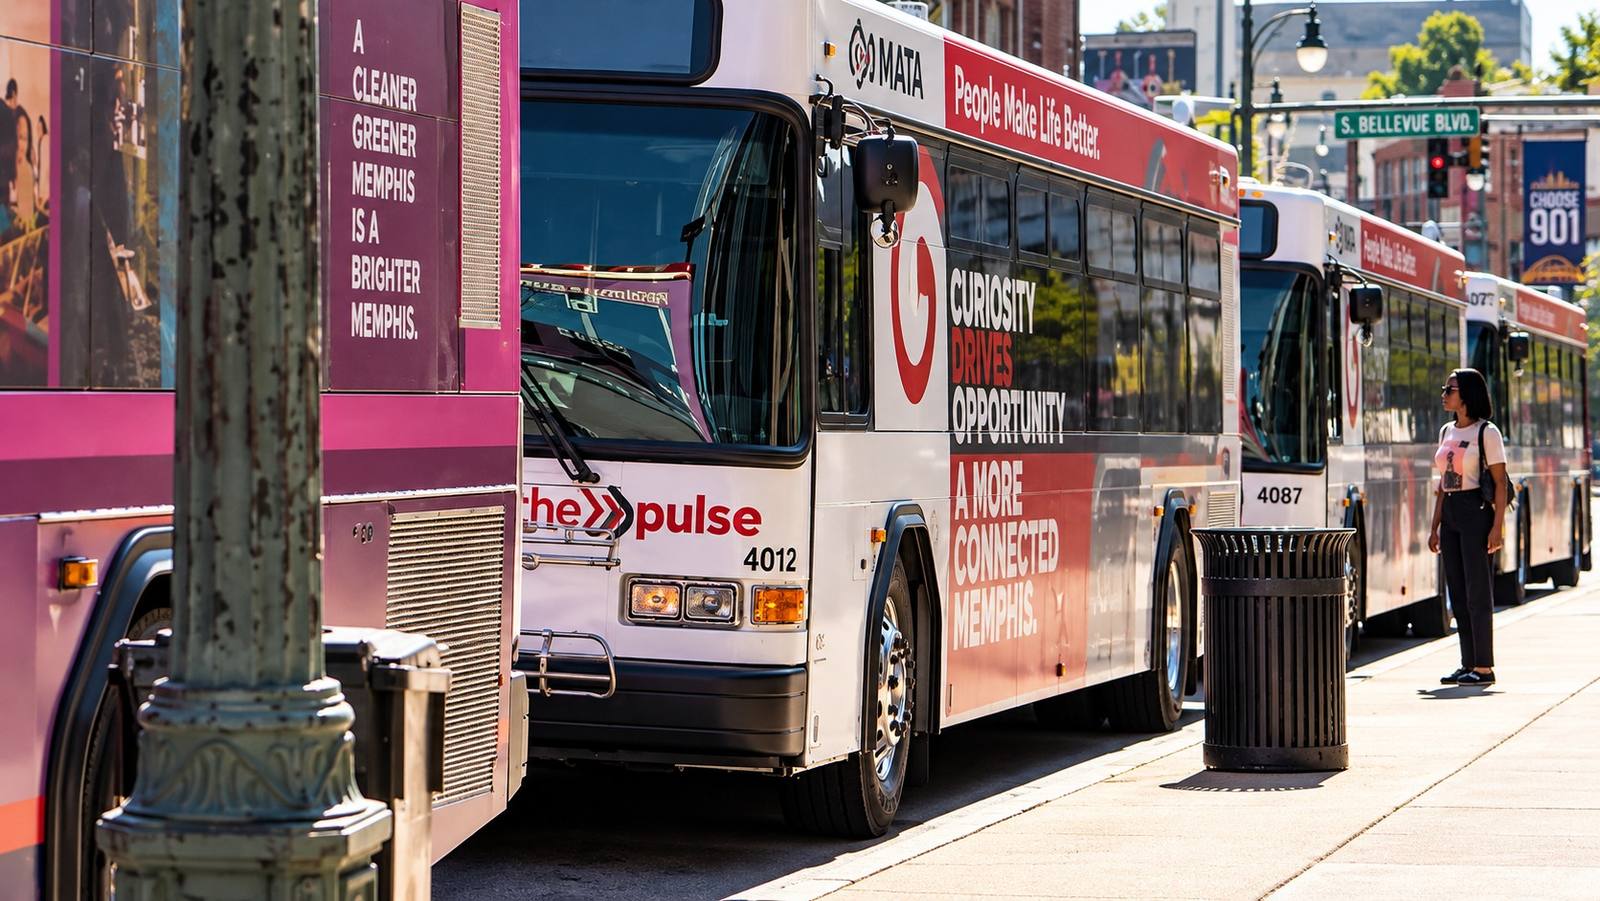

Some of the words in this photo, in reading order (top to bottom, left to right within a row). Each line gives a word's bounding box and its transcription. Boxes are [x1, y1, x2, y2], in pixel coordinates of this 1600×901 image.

[353, 19, 364, 54] A
[352, 65, 417, 112] CLEANER
[879, 37, 924, 100] MATA
[955, 64, 1000, 134] People
[1004, 82, 1037, 140] Make
[1039, 95, 1061, 147] Life
[1063, 103, 1100, 160] Better.
[1341, 116, 1355, 134] S.
[1359, 114, 1430, 134] BELLEVUE
[1435, 112, 1474, 132] BLVD.
[352, 113, 416, 158] GREENER
[352, 160, 415, 203] MEMPHIS
[1530, 191, 1580, 208] CHOOSE
[352, 207, 365, 243] IS
[368, 210, 380, 244] A
[1530, 208, 1580, 246] 901
[351, 254, 421, 294] BRIGHTER
[351, 302, 418, 340] MEMPHIS.
[950, 267, 1036, 334] CURIOSITY
[951, 326, 1013, 387] DRIVES
[952, 385, 1066, 445] OPPORTUNITY
[954, 461, 969, 520] A
[973, 460, 1023, 519] MORE
[1257, 486, 1303, 504] 4087
[636, 494, 762, 540] pulse
[743, 547, 797, 572] 4012
[954, 518, 1059, 586] CONNECTED
[953, 580, 1037, 651] MEMPHIS.
